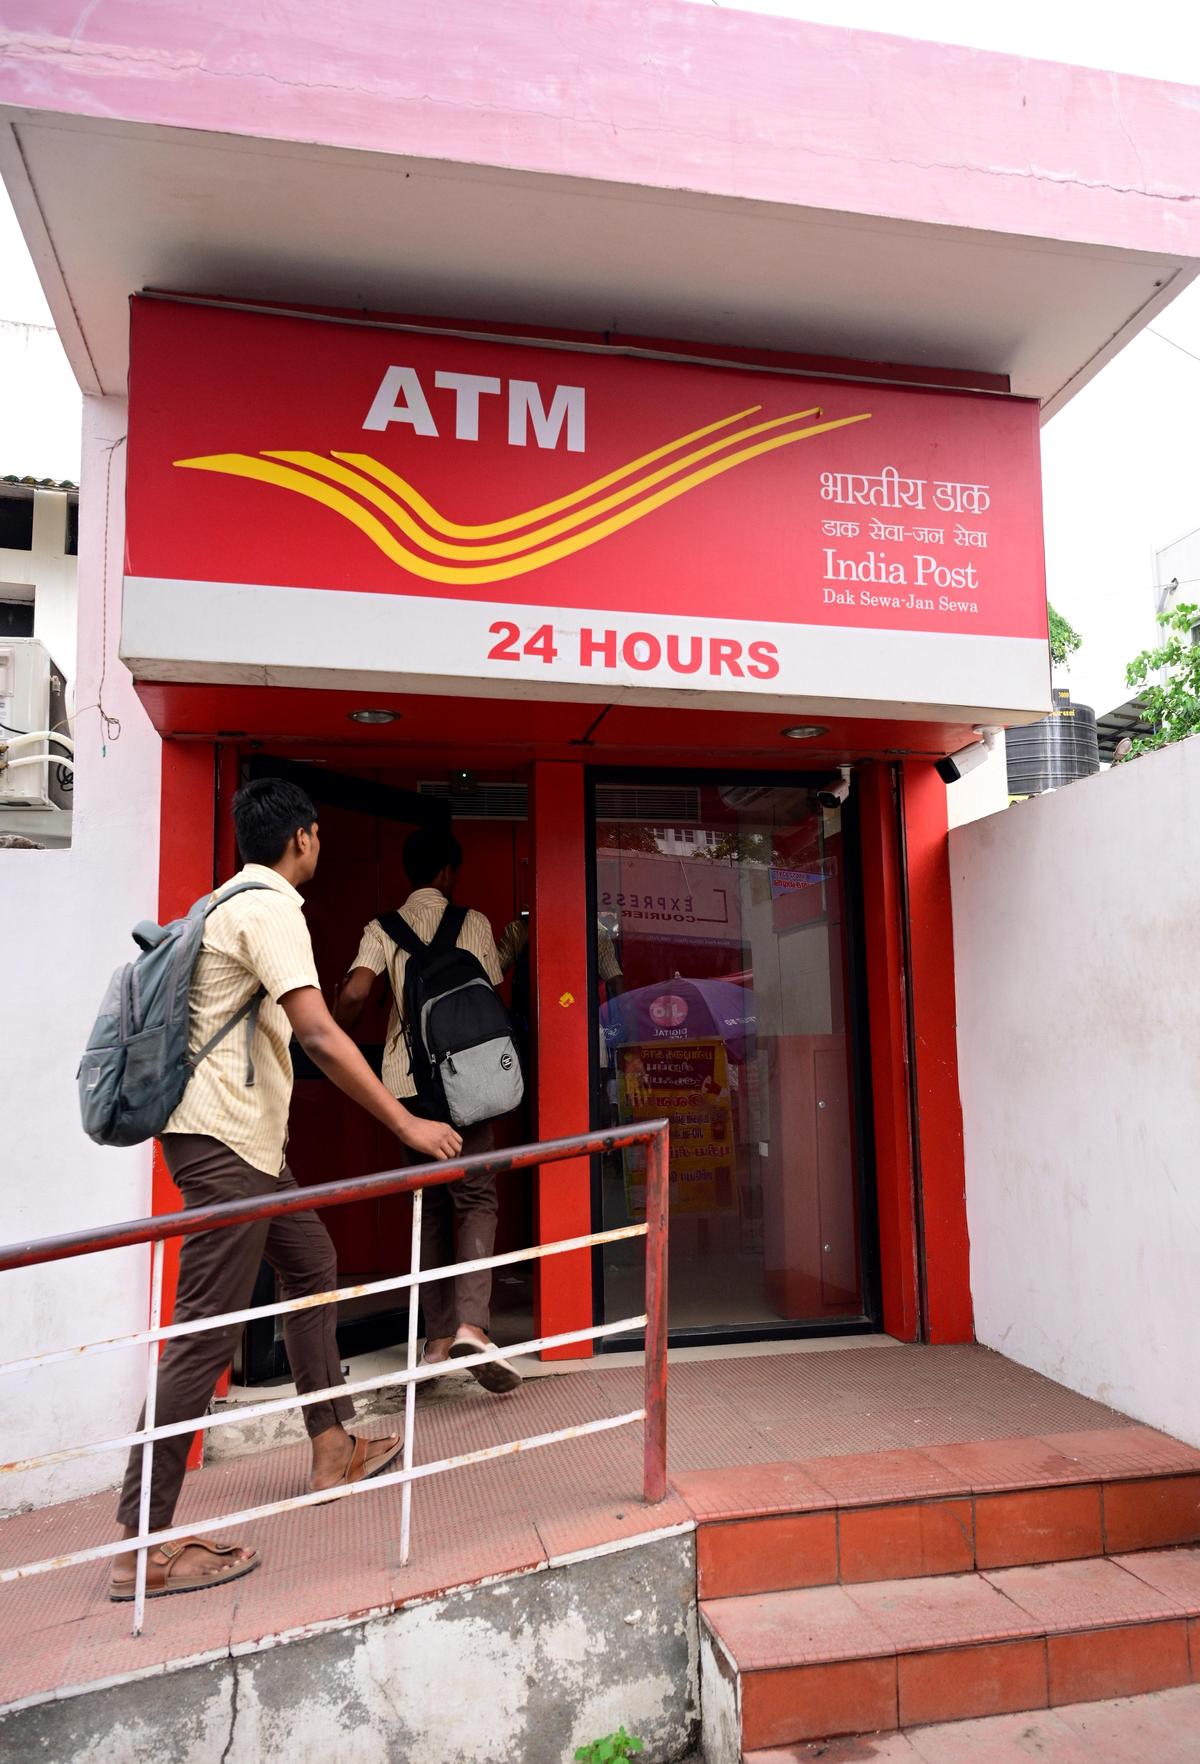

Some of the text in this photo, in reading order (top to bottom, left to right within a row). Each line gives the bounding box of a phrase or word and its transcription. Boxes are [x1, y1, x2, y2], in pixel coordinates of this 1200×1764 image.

[362, 365, 585, 453] ATM
[820, 466, 991, 514] भारतीय डाक
[821, 517, 988, 548] डाक सेवा-जन सेवा
[822, 547, 979, 589] India Post
[823, 588, 978, 613] Dak Sewa-Jan Sewa
[487, 620, 780, 680] 24 HOURS
